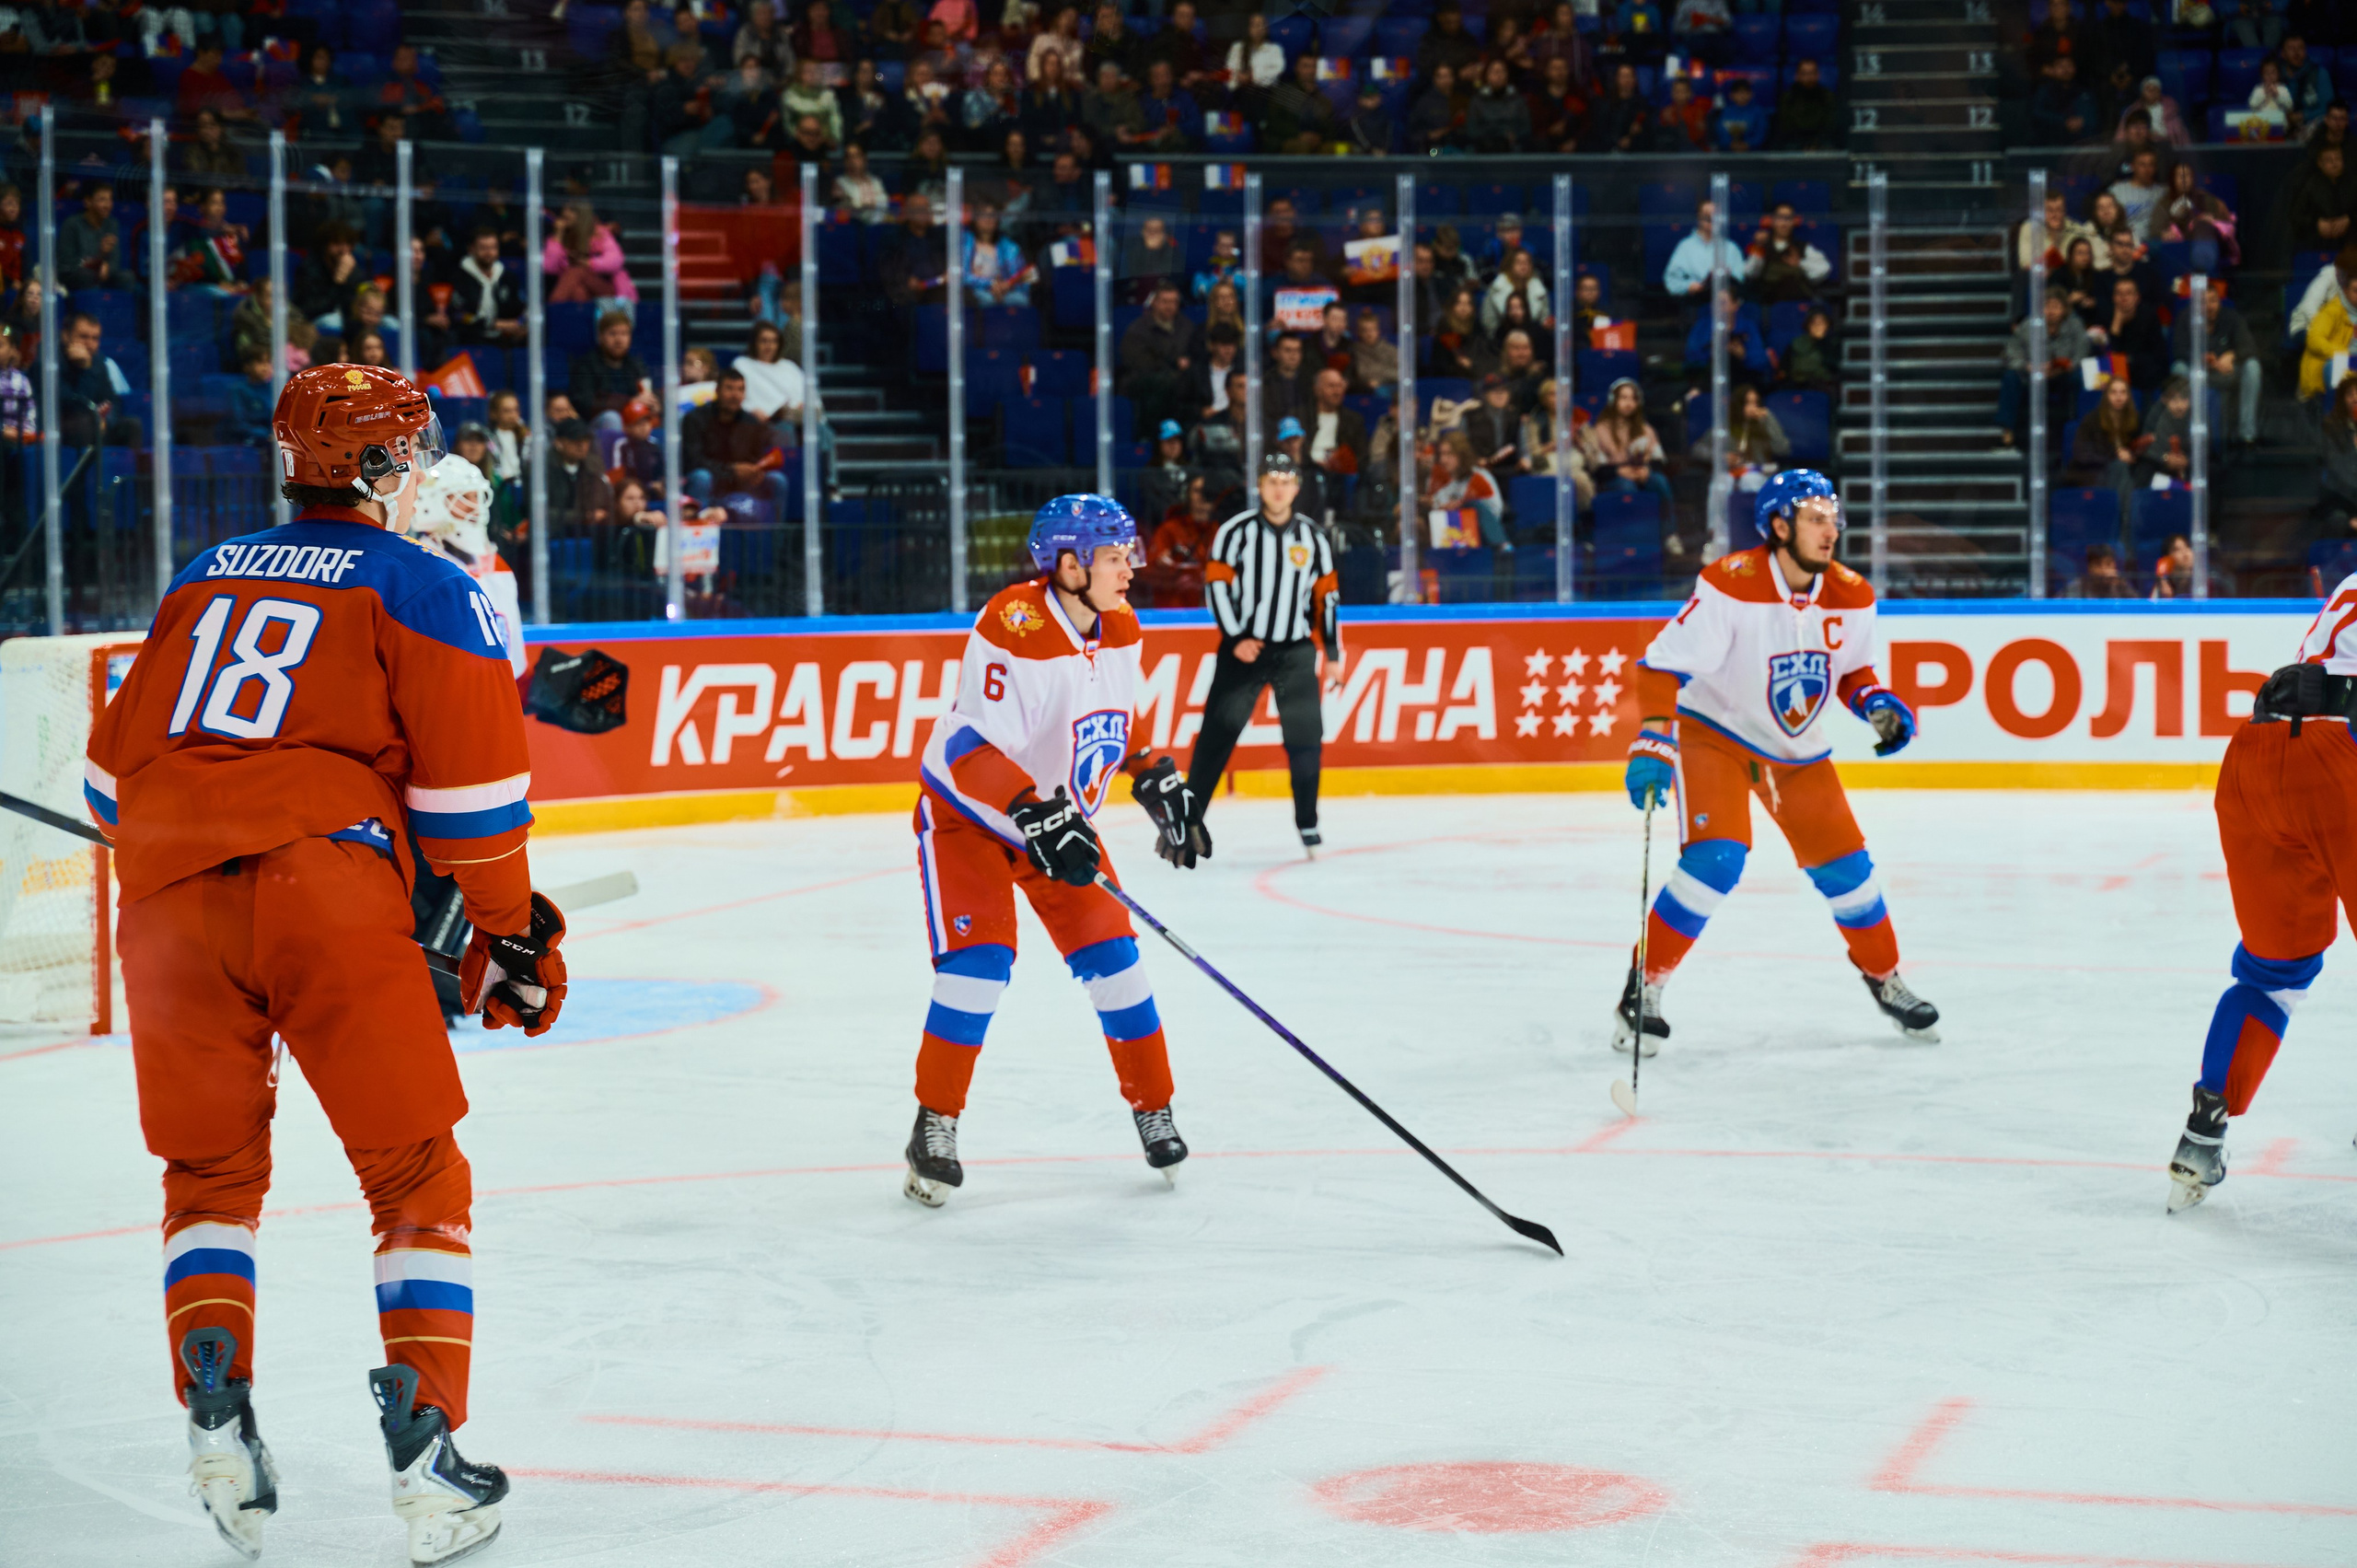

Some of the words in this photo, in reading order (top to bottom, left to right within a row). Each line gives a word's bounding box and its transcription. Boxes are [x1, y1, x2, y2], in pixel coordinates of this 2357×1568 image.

[563, 101, 590, 126] 12
[1854, 108, 1877, 131] 12
[1968, 106, 1993, 128] 12
[1972, 160, 1991, 185] 11
[205, 544, 365, 584] SUZDORF
[1822, 616, 1843, 651] C
[167, 593, 324, 739] 18
[1771, 653, 1828, 681] СХЛ
[983, 662, 1007, 703] 6
[650, 659, 963, 767] КРАСН
[1075, 714, 1126, 750] СХЛ
[501, 938, 536, 956] CCM
